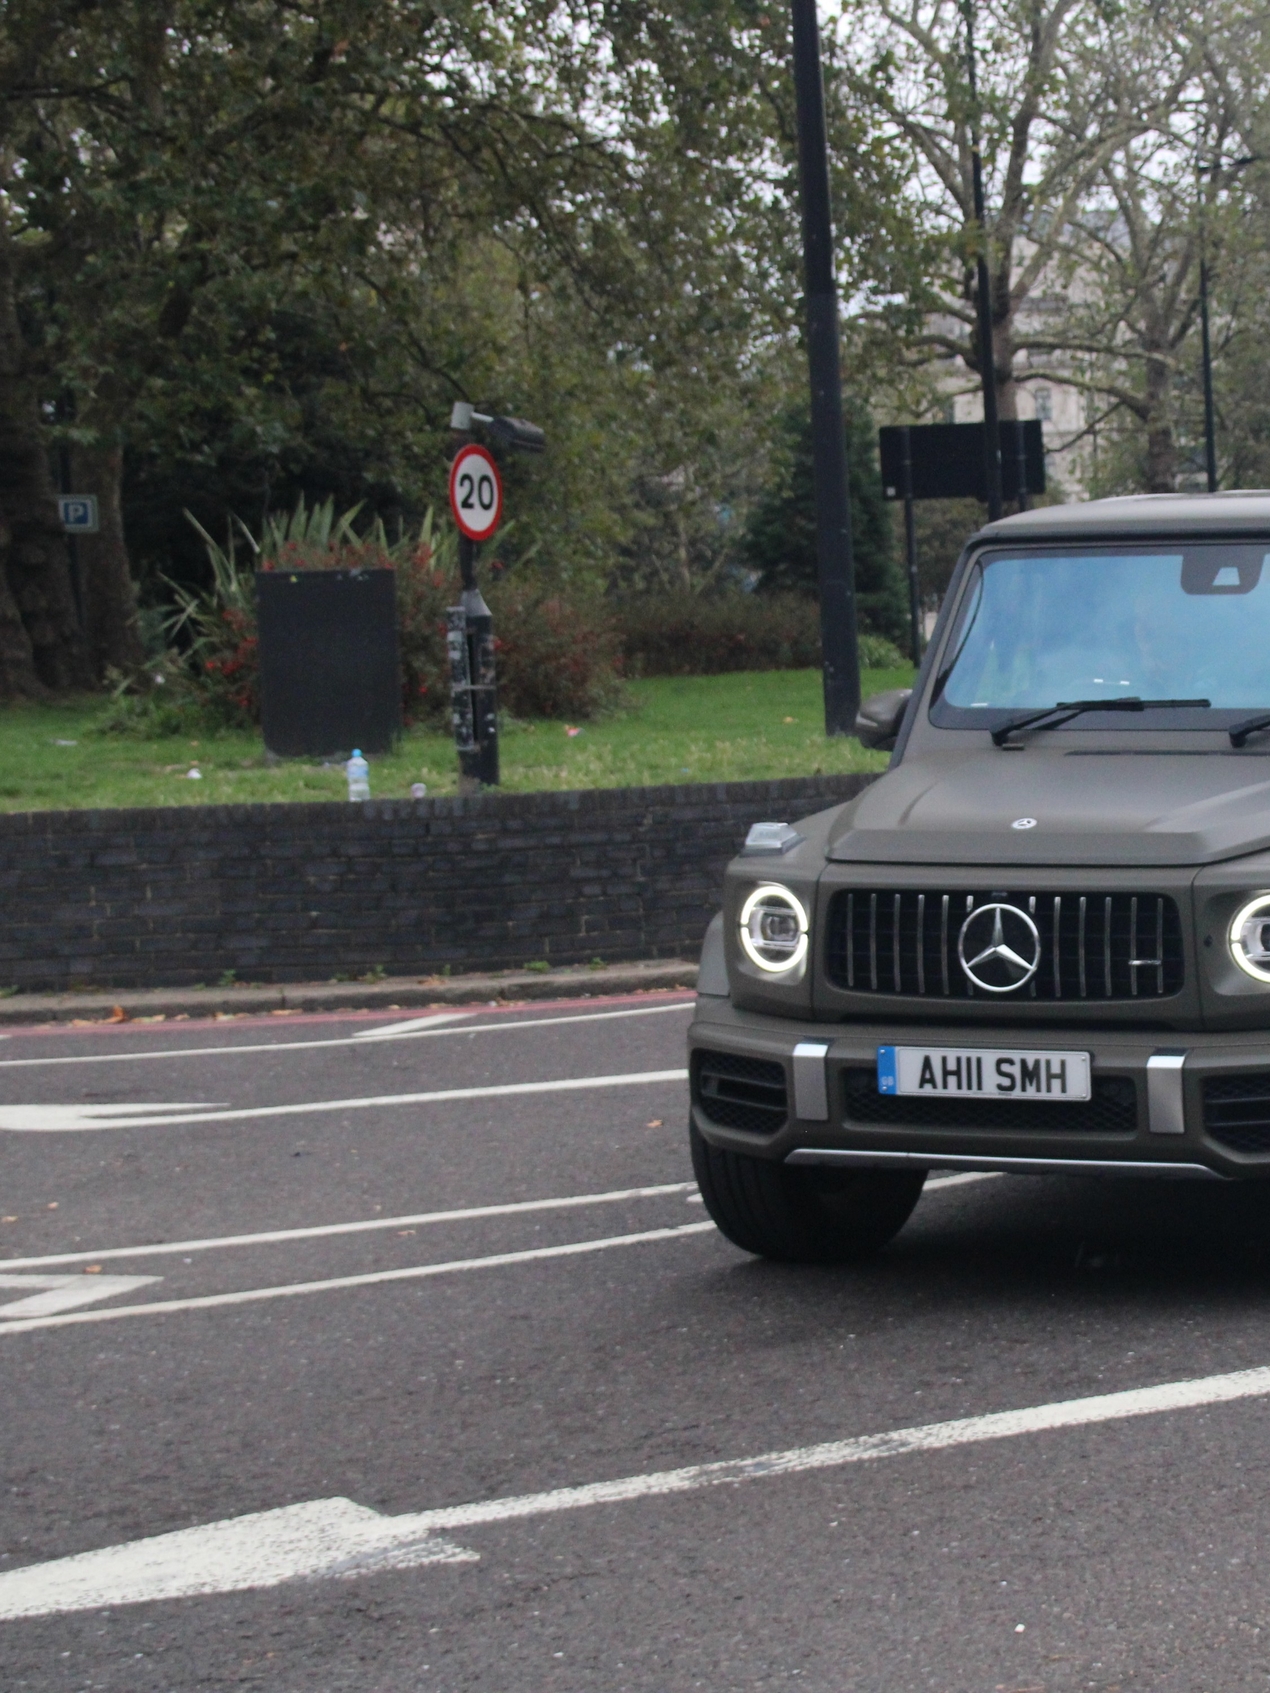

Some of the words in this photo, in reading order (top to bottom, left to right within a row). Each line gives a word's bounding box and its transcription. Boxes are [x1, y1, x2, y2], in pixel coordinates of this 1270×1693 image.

[459, 473, 494, 511] 20
[68, 504, 85, 522] P
[996, 1057, 1067, 1093] SMH
